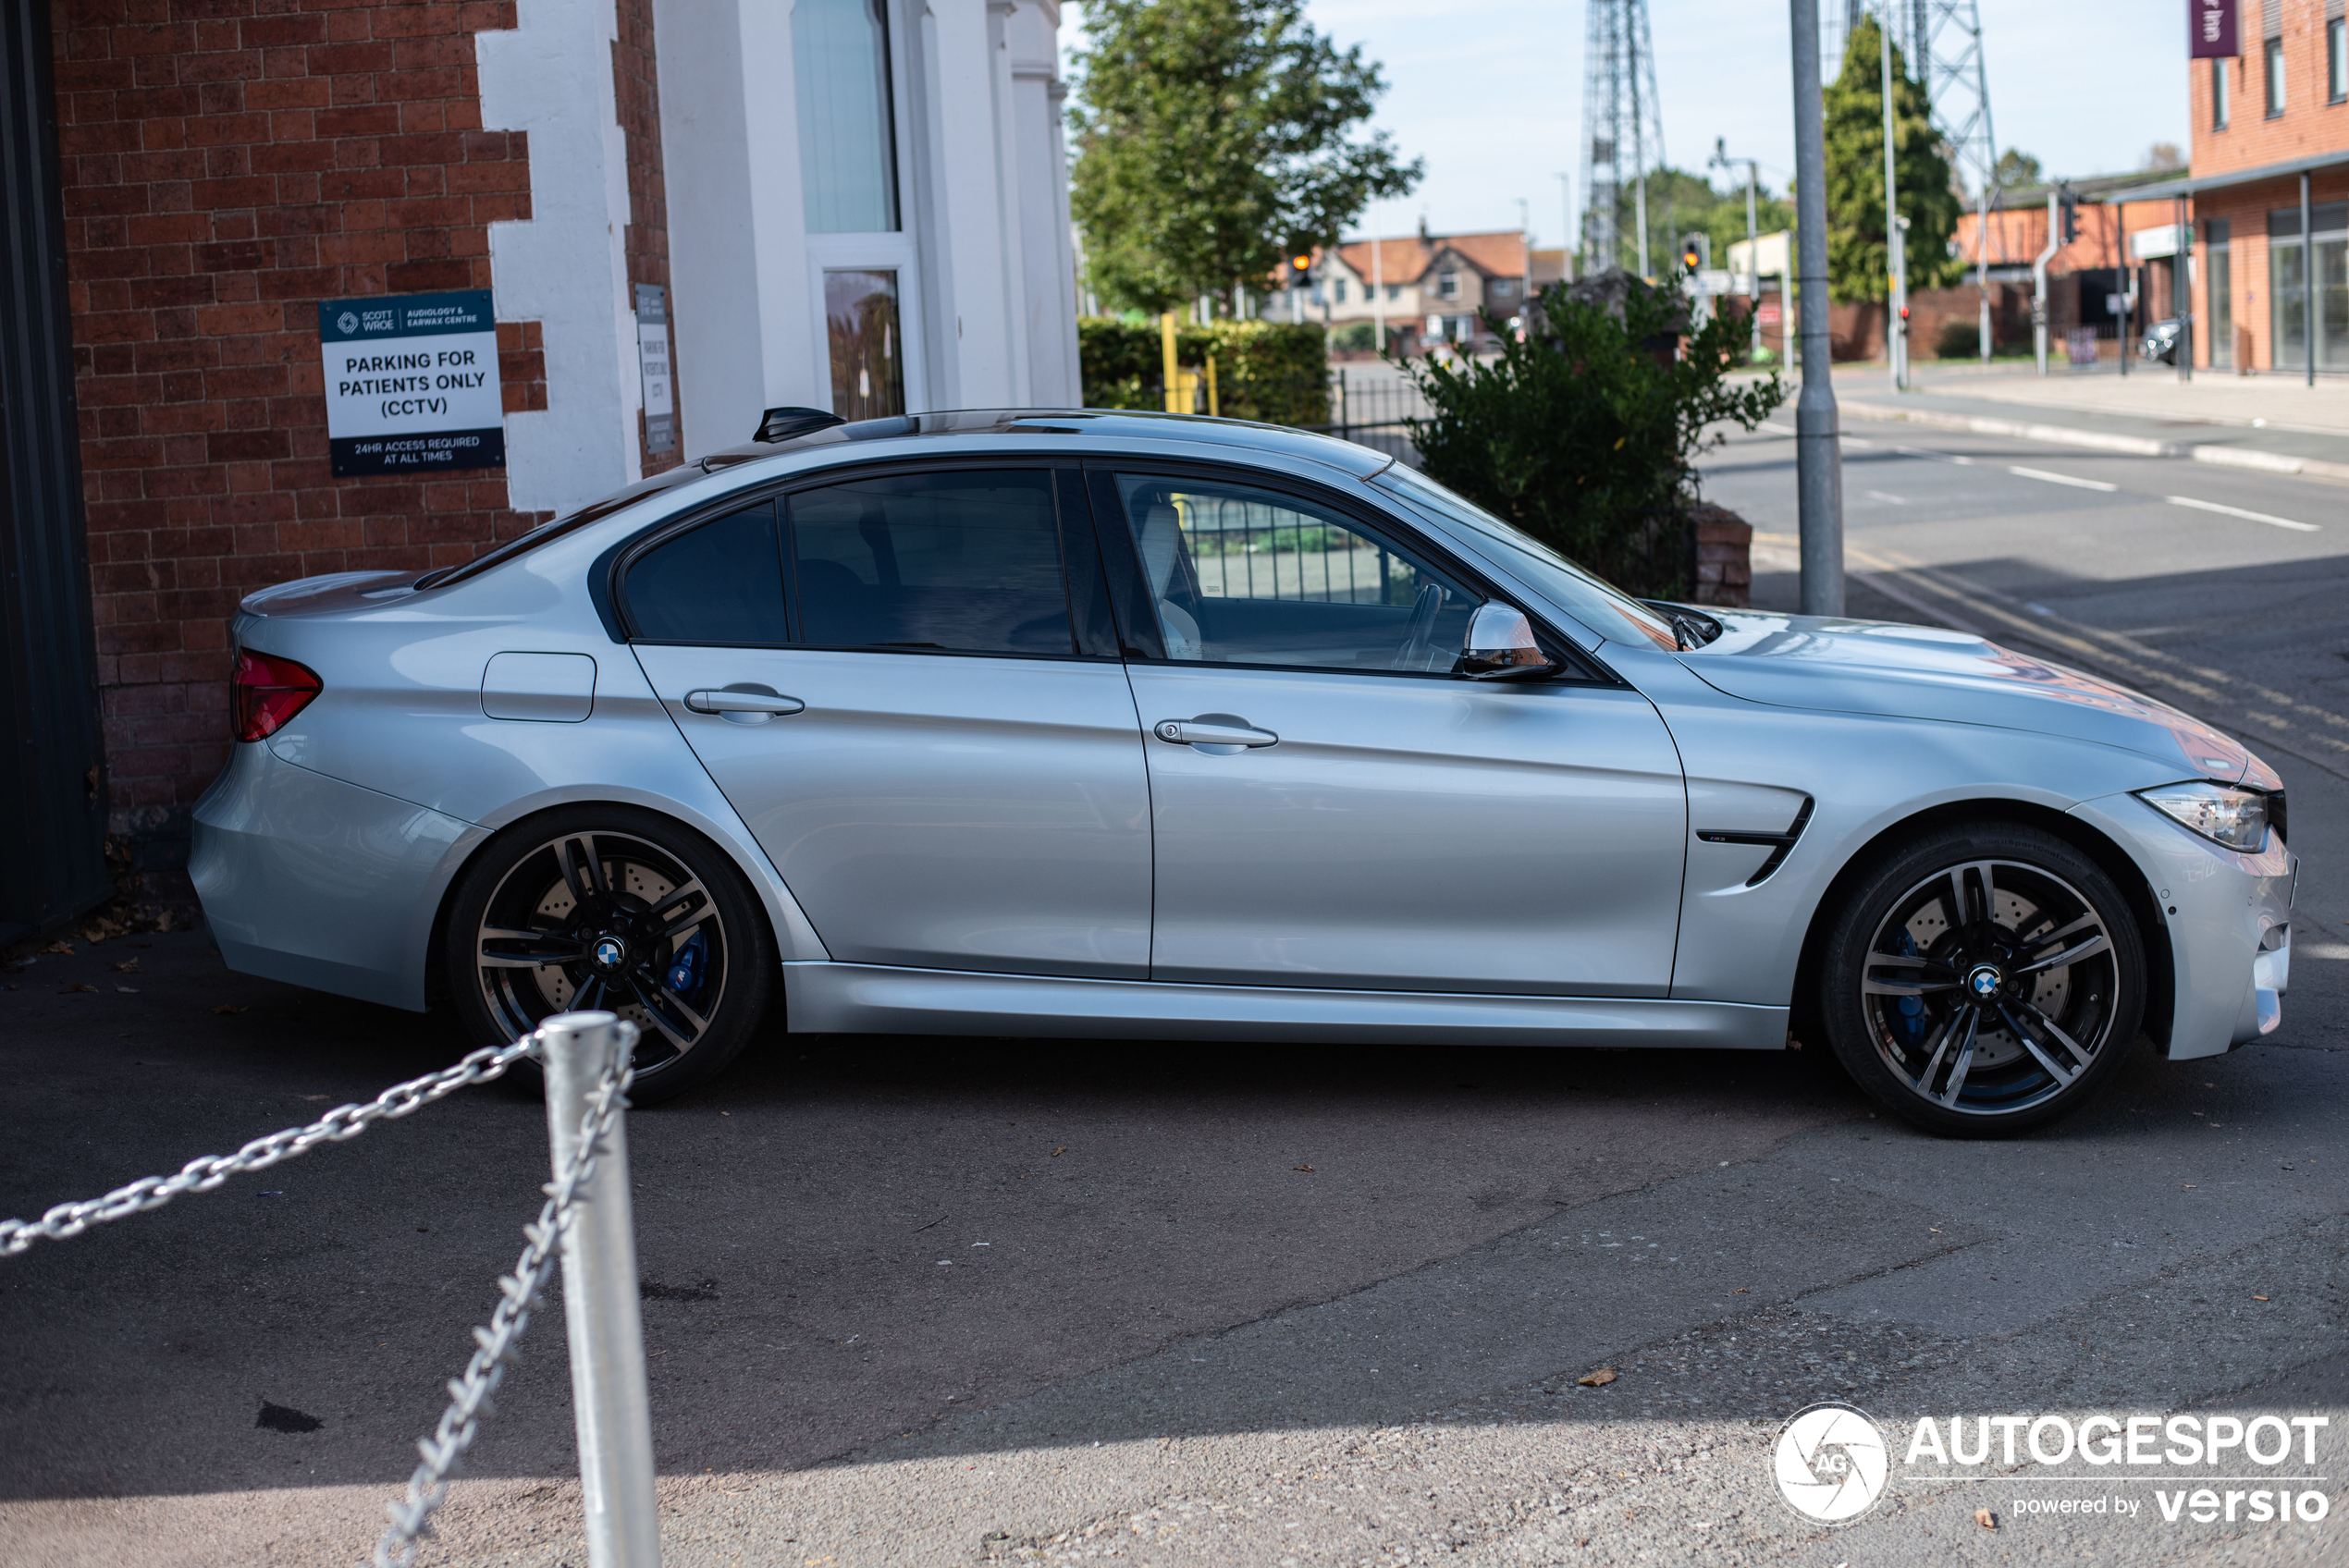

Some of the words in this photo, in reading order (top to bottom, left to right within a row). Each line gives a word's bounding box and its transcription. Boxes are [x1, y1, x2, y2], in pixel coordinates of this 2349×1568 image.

[362, 310, 393, 321] SCOTT
[407, 307, 455, 318] AUDIOLOGY
[457, 306, 463, 314] &
[363, 319, 394, 332] WROE
[407, 317, 443, 327] EARWAX
[445, 314, 477, 325] CENTRE
[346, 352, 431, 374] PARKING
[437, 350, 475, 367] FOR
[339, 376, 429, 397] PATIENTS
[437, 372, 486, 389] ONLY
[381, 398, 448, 419] (CCTV)
[354, 443, 383, 455] 24HR
[385, 439, 426, 452] ACCESS
[428, 435, 480, 449] REQUIRED
[384, 454, 397, 465] AT
[400, 452, 419, 464] ALL
[422, 450, 452, 462] TIMES
